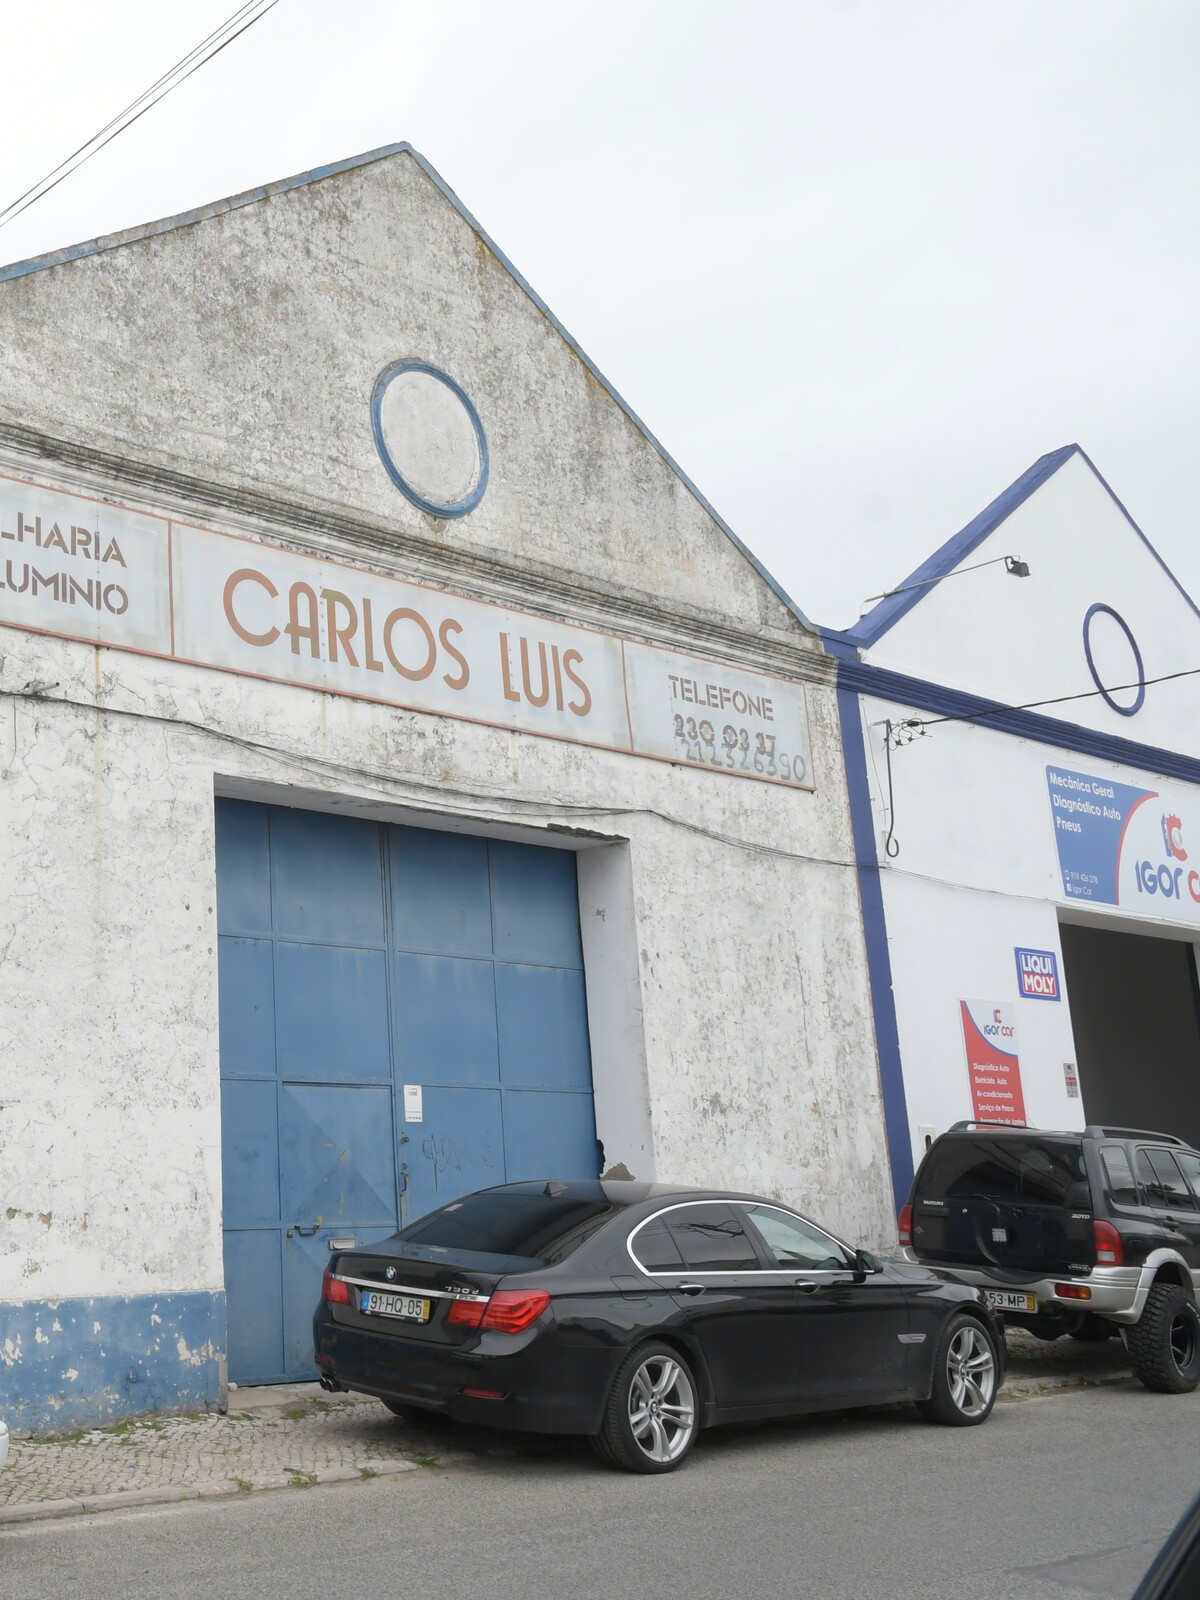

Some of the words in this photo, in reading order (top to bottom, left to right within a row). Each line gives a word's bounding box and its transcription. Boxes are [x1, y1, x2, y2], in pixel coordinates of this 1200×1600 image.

[223, 568, 470, 691] CARLOS
[499, 631, 592, 717] LUIS
[668, 674, 774, 721] TELEFONE
[1091, 782, 1115, 799] Geral
[1052, 794, 1102, 816] Diagnóstico
[1103, 806, 1121, 821] Auto
[1056, 816, 1082, 833] Pneus
[1021, 954, 1052, 974] LIQUI
[1023, 973, 1054, 994] MOLY
